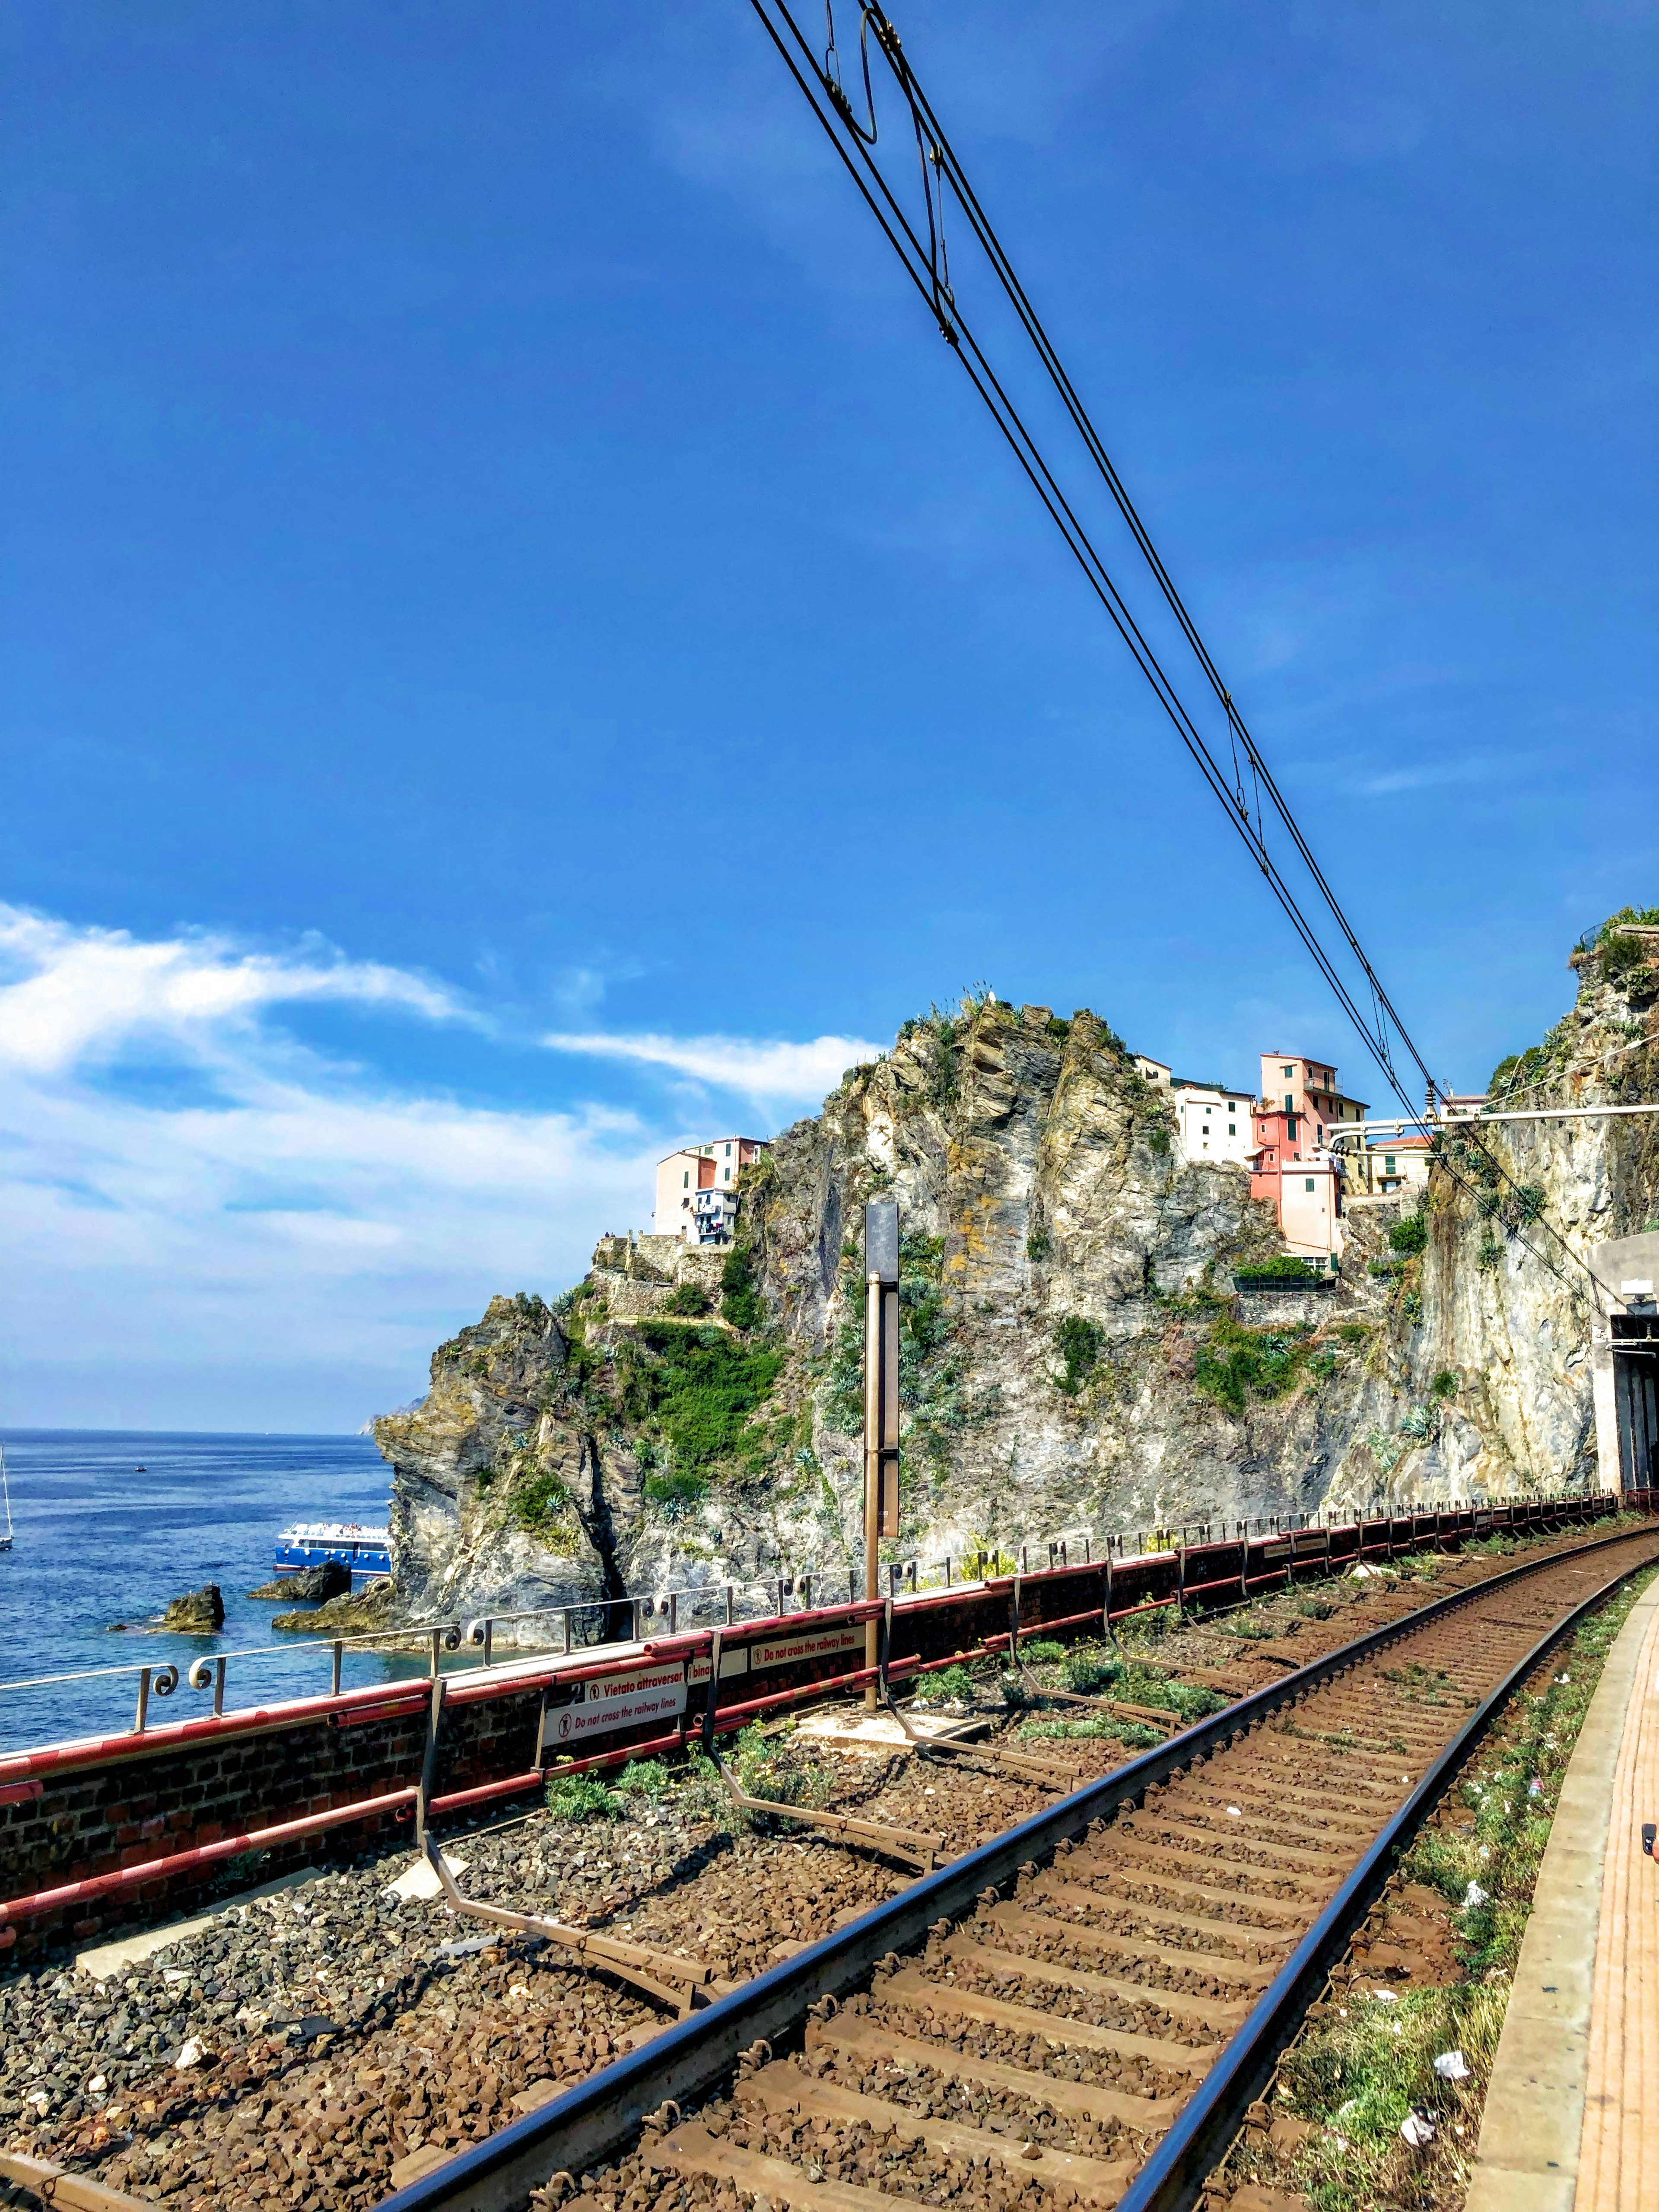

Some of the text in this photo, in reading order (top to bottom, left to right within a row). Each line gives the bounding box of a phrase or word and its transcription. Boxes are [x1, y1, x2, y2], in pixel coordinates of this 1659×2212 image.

[764, 1634, 855, 1662] Do not cross the railway lines
[604, 1681, 635, 1697] Vietato
[637, 1672, 683, 1690] attraversar
[575, 1697, 676, 1729] Do not cross the railway lines
